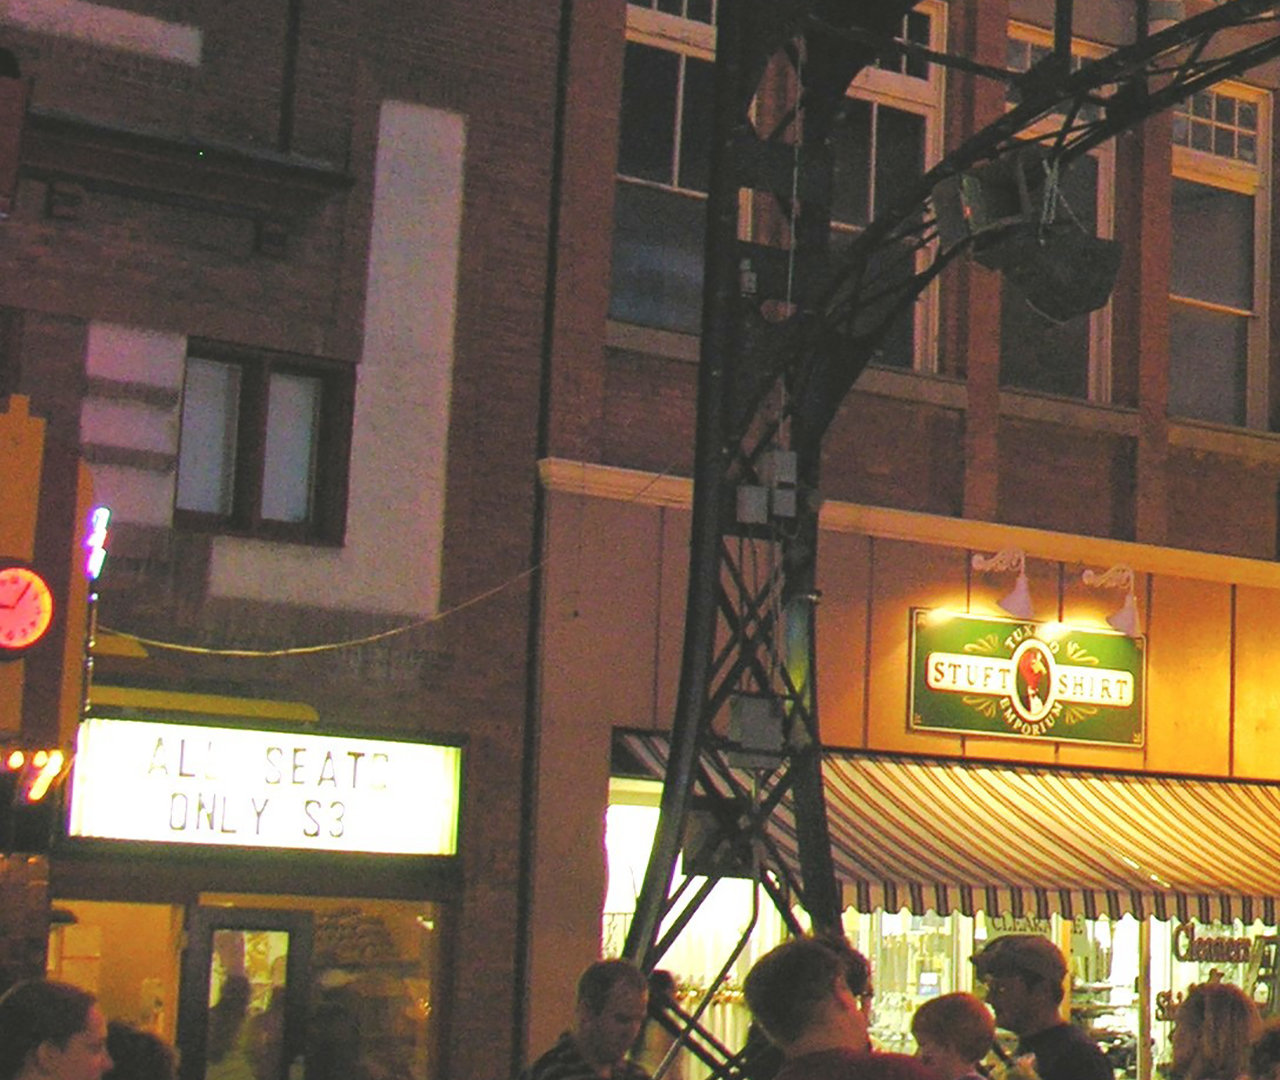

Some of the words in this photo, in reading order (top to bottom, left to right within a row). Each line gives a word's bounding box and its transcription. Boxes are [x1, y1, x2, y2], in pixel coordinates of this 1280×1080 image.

[1004, 624, 1060, 655] TUXO
[933, 661, 1011, 690] STUFT
[1058, 673, 1128, 701] SHIRT
[1000, 697, 1064, 736] EMPORIUM
[148, 737, 224, 781] ALL
[169, 792, 269, 836] ONLY
